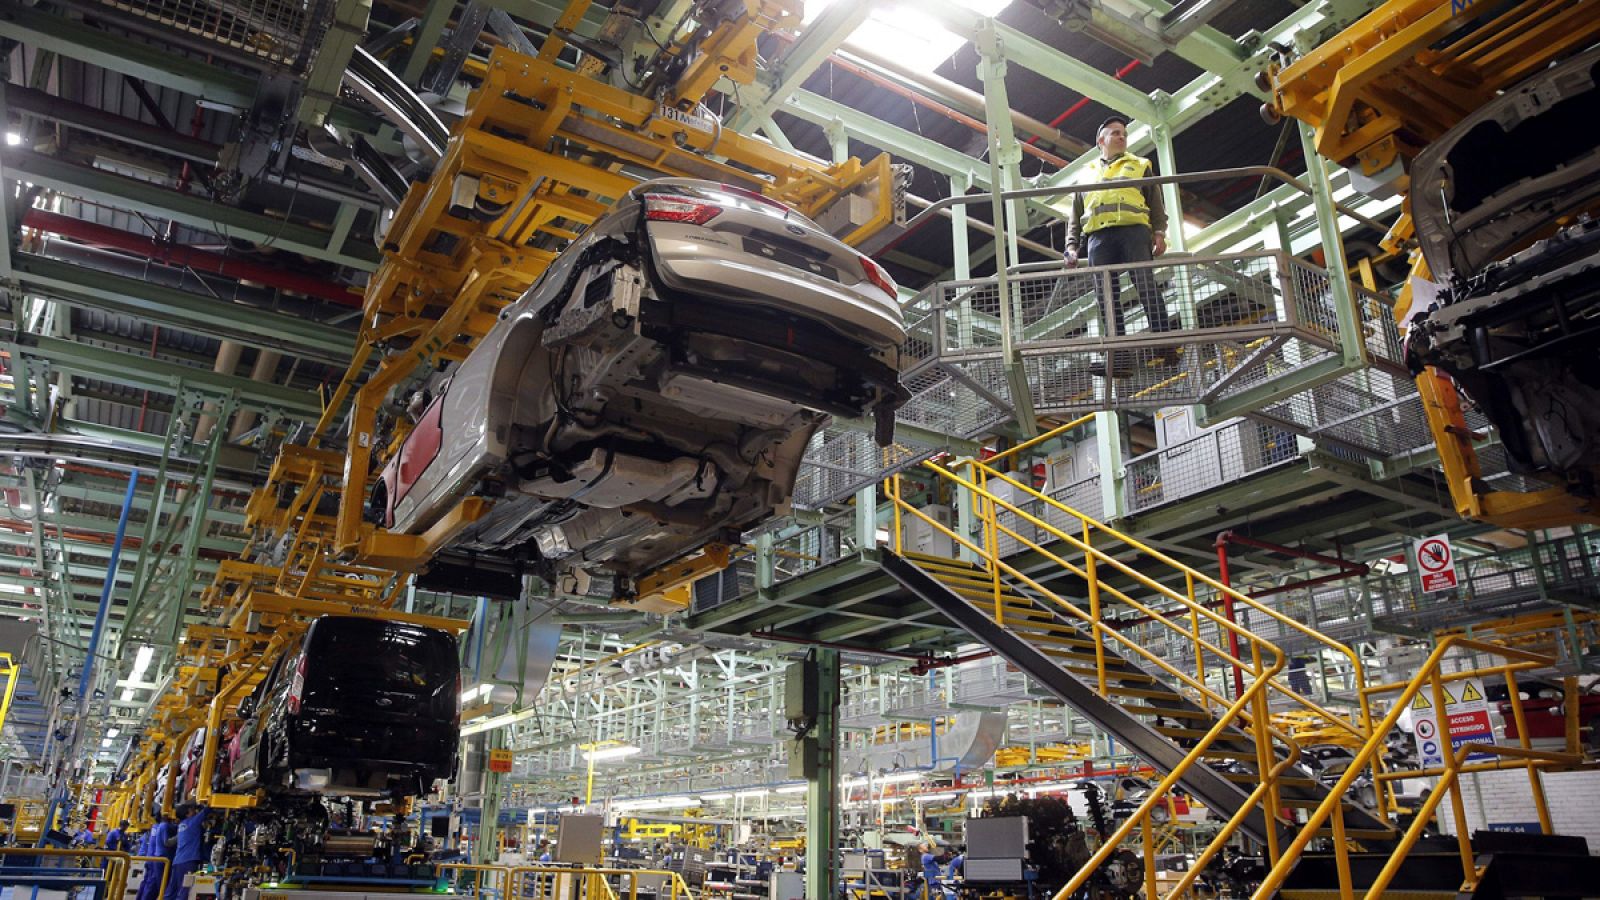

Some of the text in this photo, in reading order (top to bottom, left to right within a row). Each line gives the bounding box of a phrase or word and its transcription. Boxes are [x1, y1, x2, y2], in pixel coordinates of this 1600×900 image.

[662, 106, 678, 121] 131
[1451, 715, 1475, 724] ACCESO
[1448, 723, 1485, 734] ESTRINGIDO
